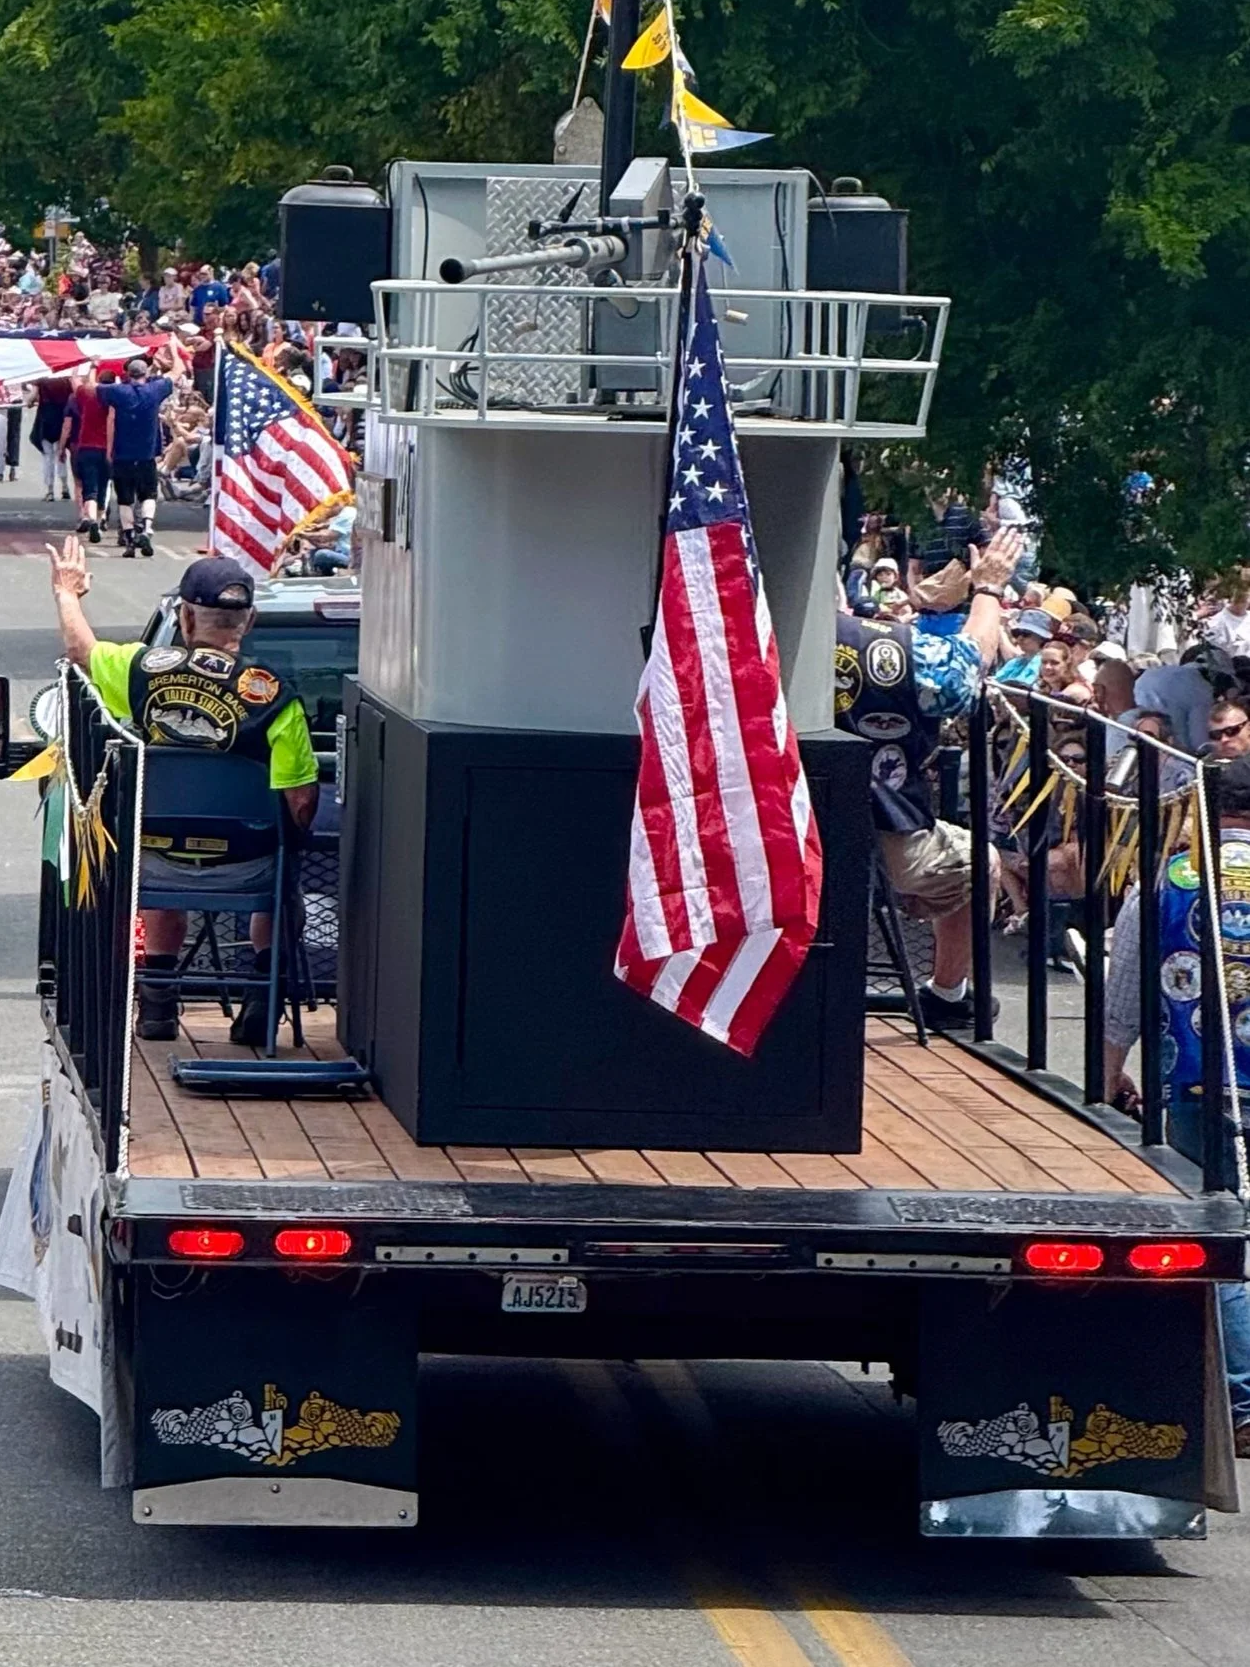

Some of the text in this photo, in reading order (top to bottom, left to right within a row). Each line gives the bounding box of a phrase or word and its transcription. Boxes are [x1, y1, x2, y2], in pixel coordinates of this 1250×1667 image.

[148, 674, 249, 721] BREMERTON BASE
[164, 690, 228, 719] UNITED STATES
[512, 1285, 580, 1309] AJ5215
